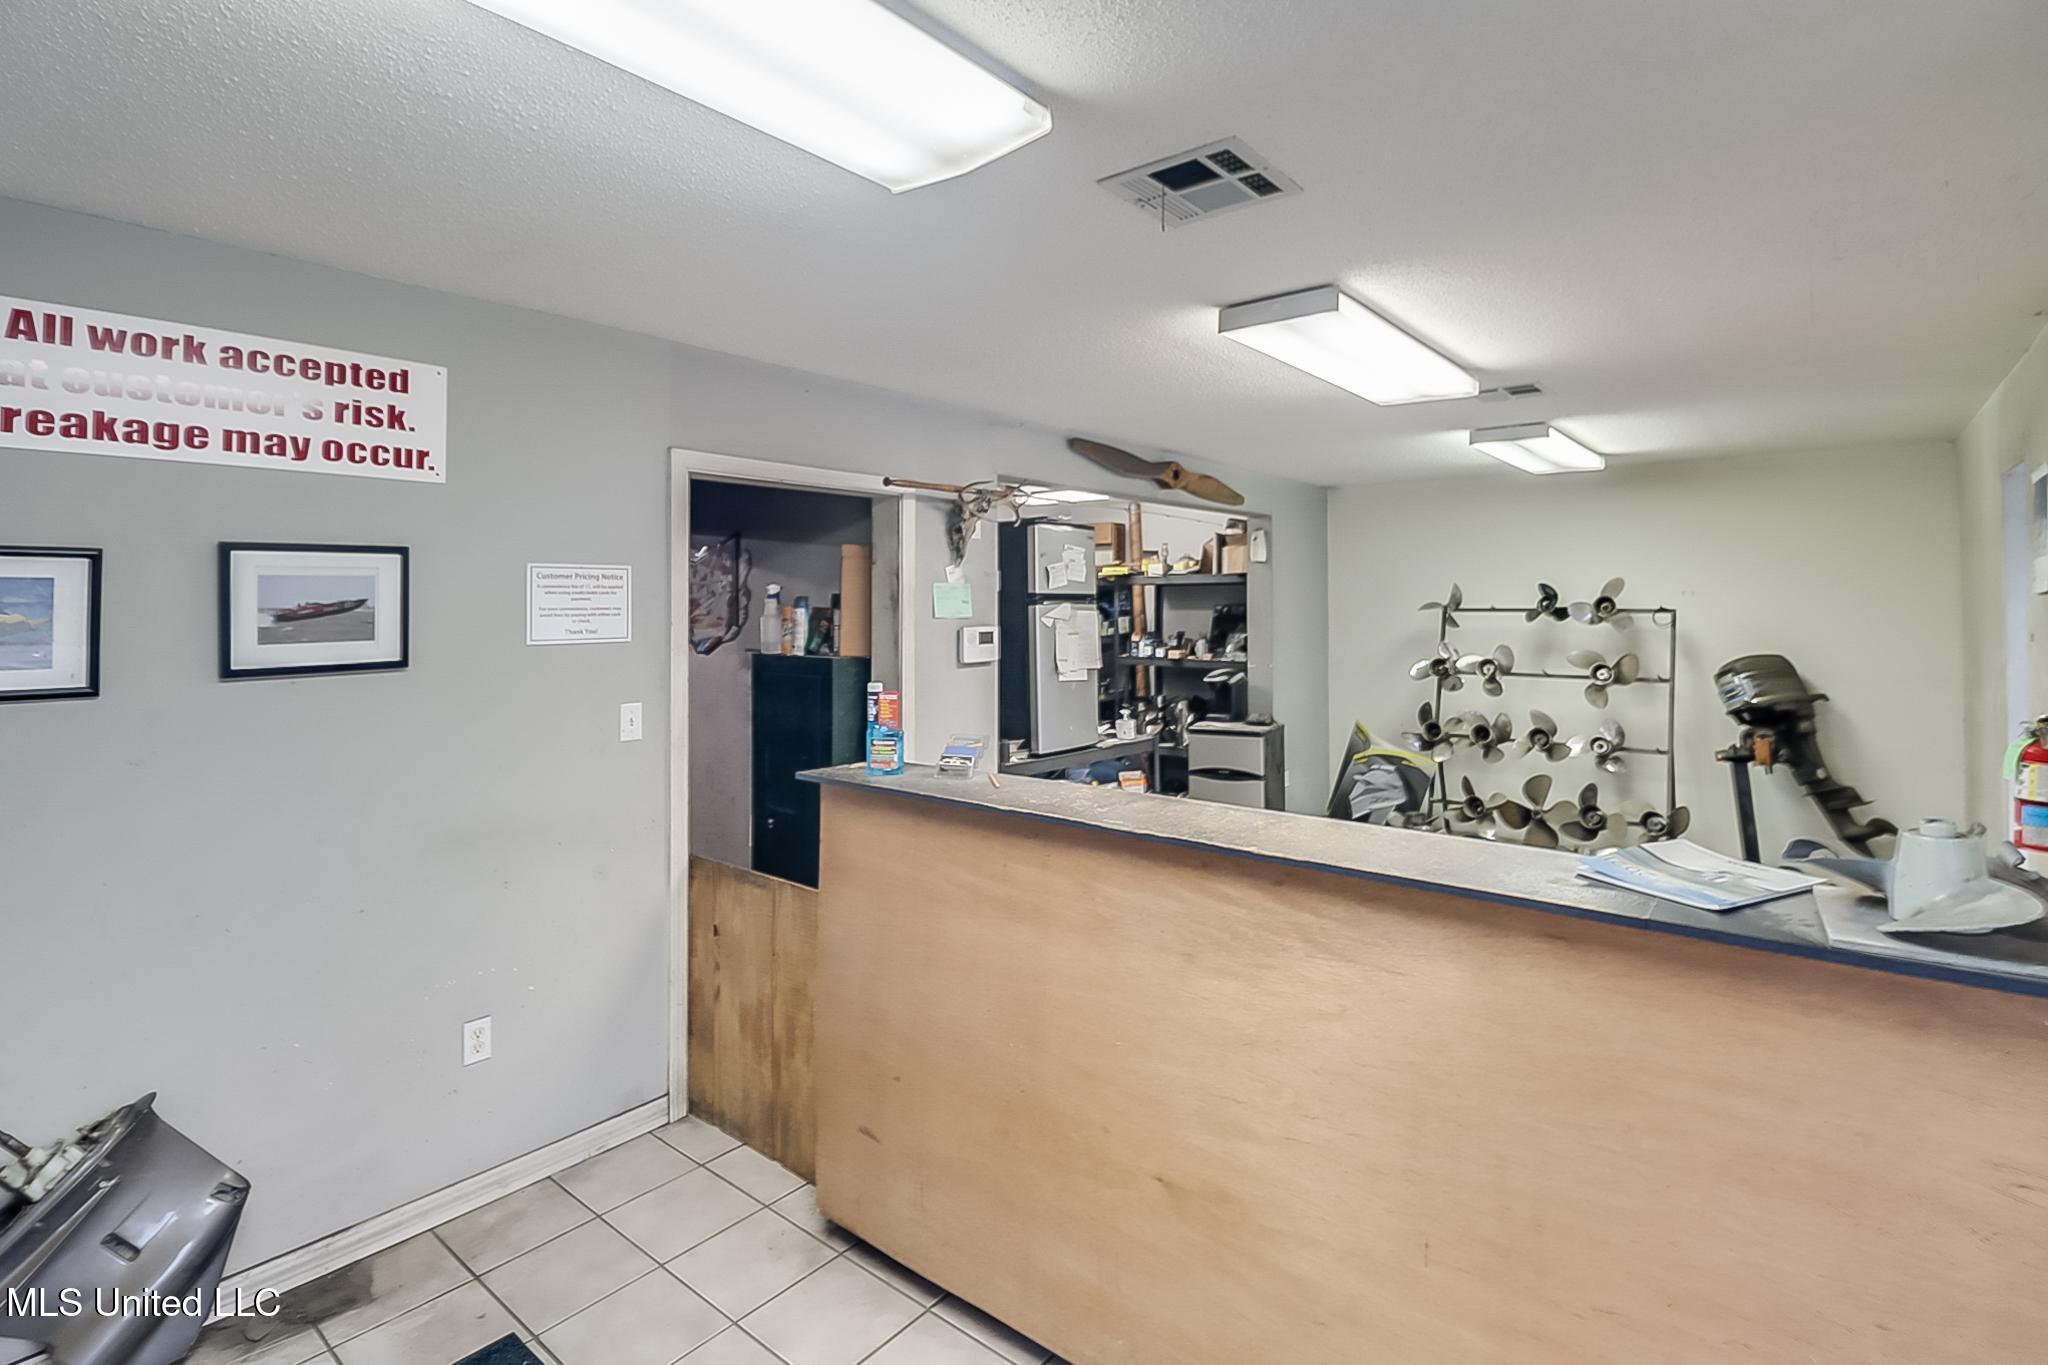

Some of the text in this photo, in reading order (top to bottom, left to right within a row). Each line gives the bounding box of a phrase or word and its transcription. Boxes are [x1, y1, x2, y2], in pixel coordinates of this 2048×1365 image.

[4, 307, 410, 395] All work accepted
[0, 359, 49, 390] at
[334, 399, 417, 432] risk.
[0, 406, 436, 472] reakage may occur.
[536, 572, 574, 580] Customer
[575, 573, 600, 581] Pricing
